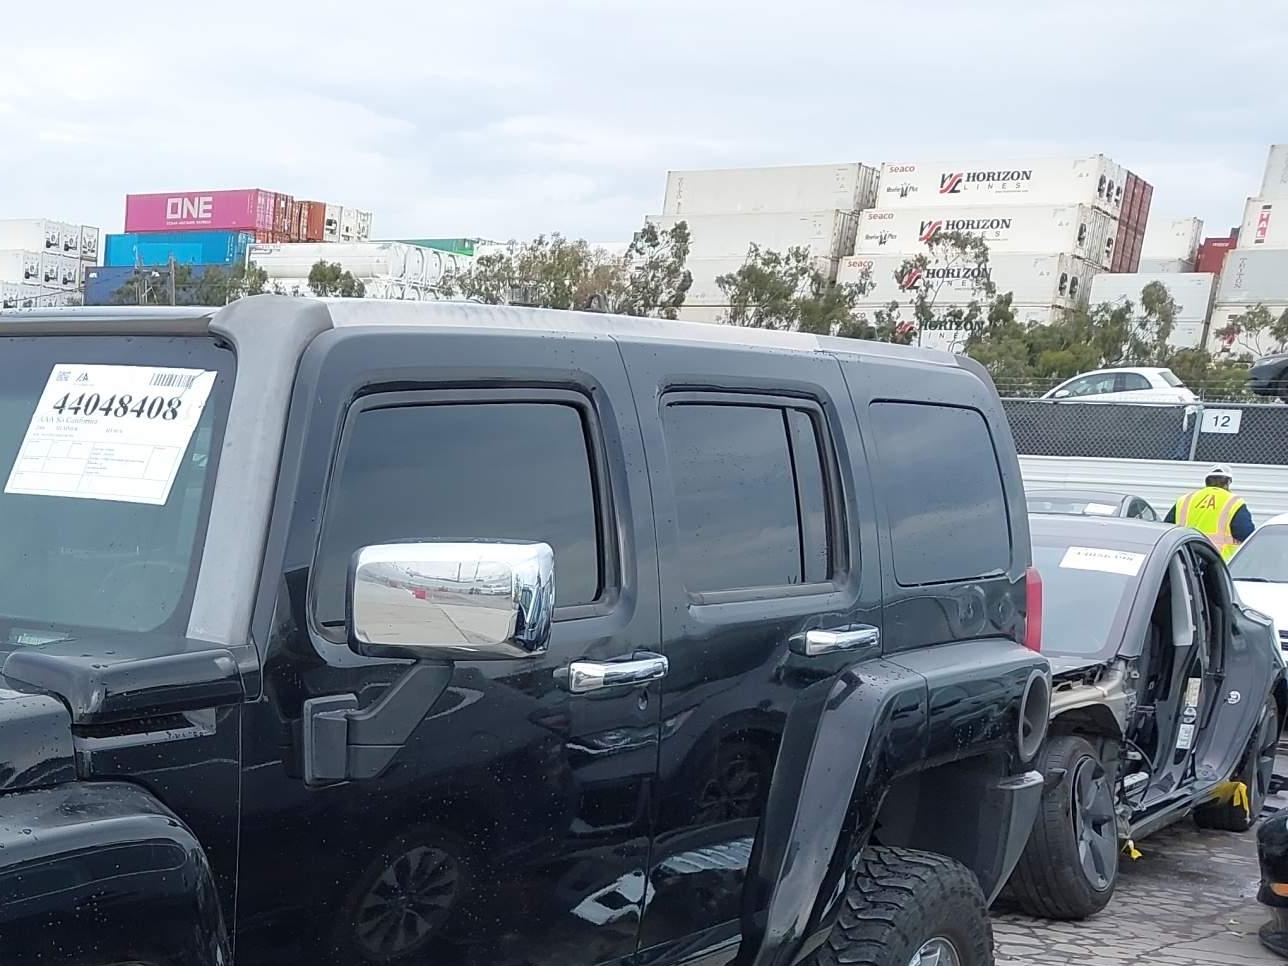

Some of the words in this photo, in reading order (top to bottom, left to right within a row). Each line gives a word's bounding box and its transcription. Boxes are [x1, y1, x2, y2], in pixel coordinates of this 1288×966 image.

[888, 164, 916, 174] seaco
[965, 169, 1033, 183] HORIZON
[964, 182, 1022, 191] LINES
[166, 196, 214, 219] ONE
[867, 212, 895, 222] seaco
[944, 218, 1012, 230] HORIZON
[925, 267, 993, 279] HORIZON
[52, 391, 182, 421] 44048408
[1212, 414, 1231, 428] 12
